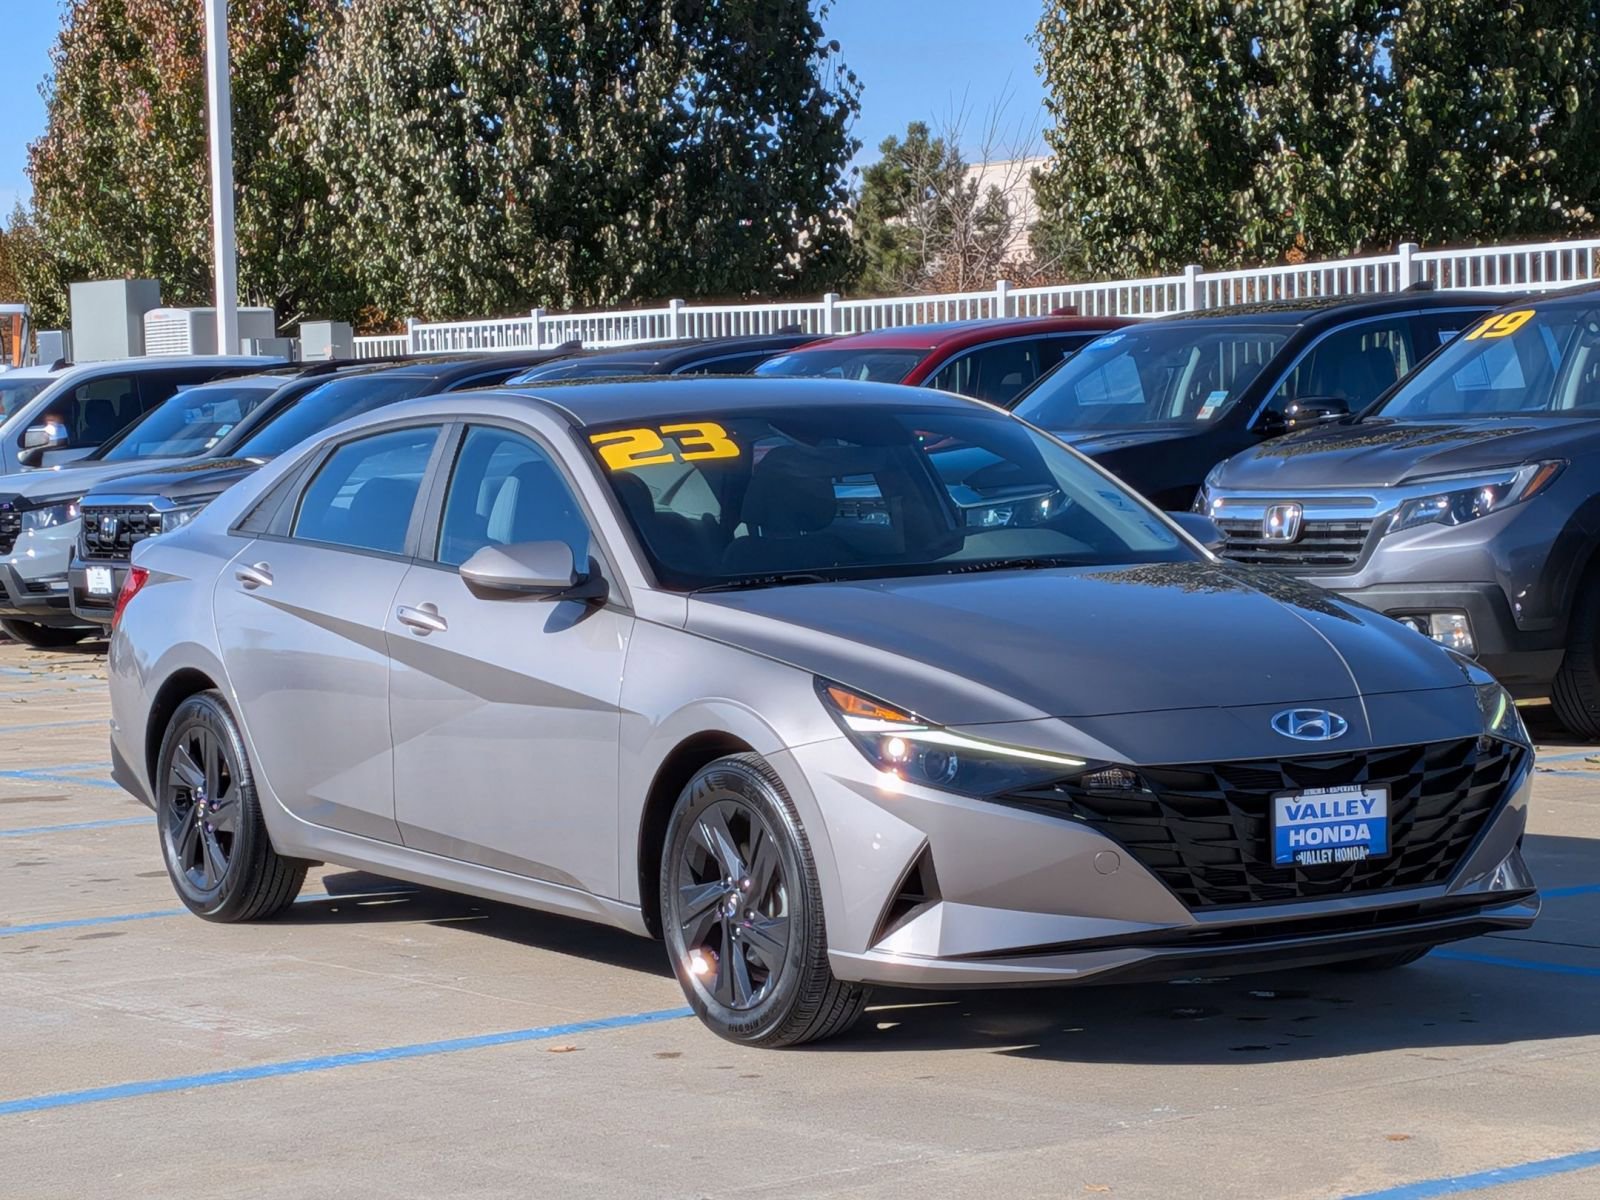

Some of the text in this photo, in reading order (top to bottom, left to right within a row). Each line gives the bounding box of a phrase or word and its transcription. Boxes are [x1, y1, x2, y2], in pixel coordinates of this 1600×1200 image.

[1464, 310, 1536, 341] 19
[589, 422, 740, 471] 23
[1284, 798, 1376, 821] VALLEY
[1289, 823, 1371, 847] HONDA
[1300, 846, 1366, 865] VALLEY HONDA
